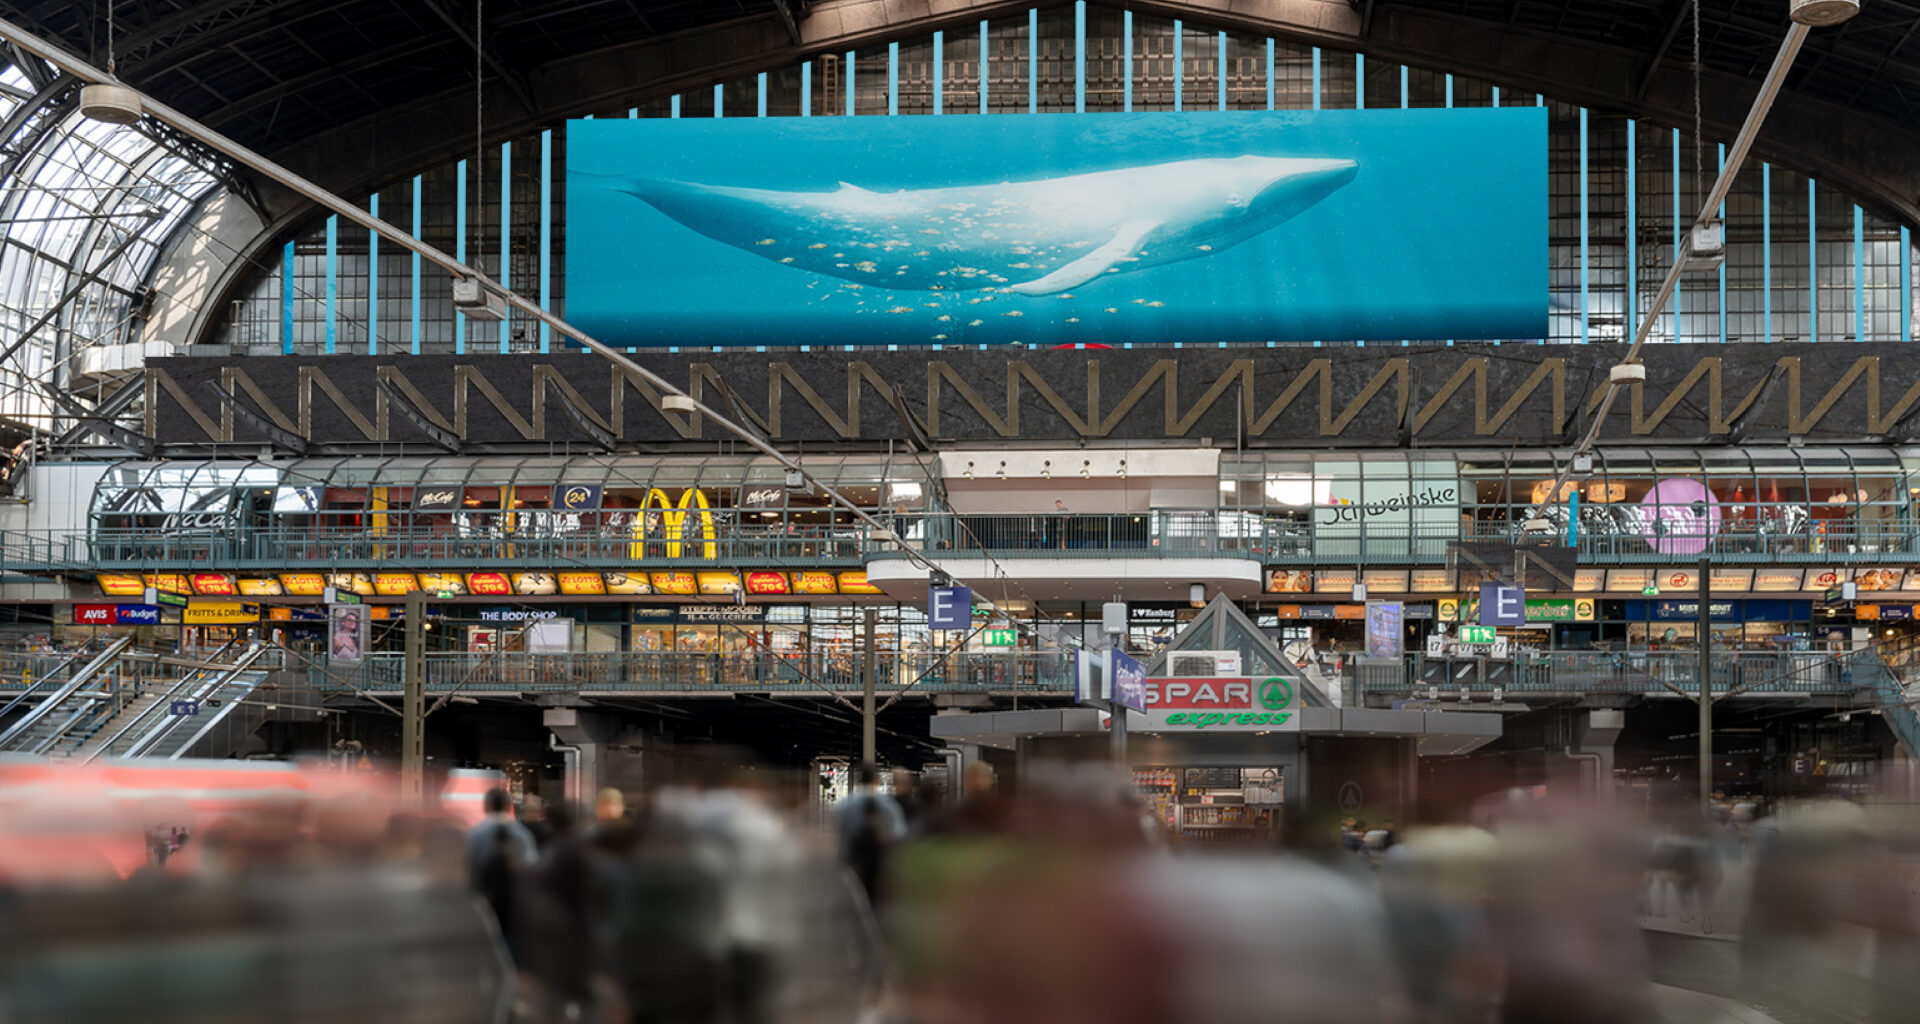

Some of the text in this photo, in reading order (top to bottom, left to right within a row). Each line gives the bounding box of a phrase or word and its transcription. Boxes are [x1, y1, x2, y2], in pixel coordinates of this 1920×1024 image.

[570, 492, 587, 504] 24
[933, 590, 954, 622] E
[1497, 586, 1518, 618] E
[83, 609, 108, 619] AVIS
[130, 608, 157, 620] Budget
[480, 610, 558, 621] THE BODY SHOP
[1165, 711, 1292, 729] express
[1795, 759, 1804, 773] E
